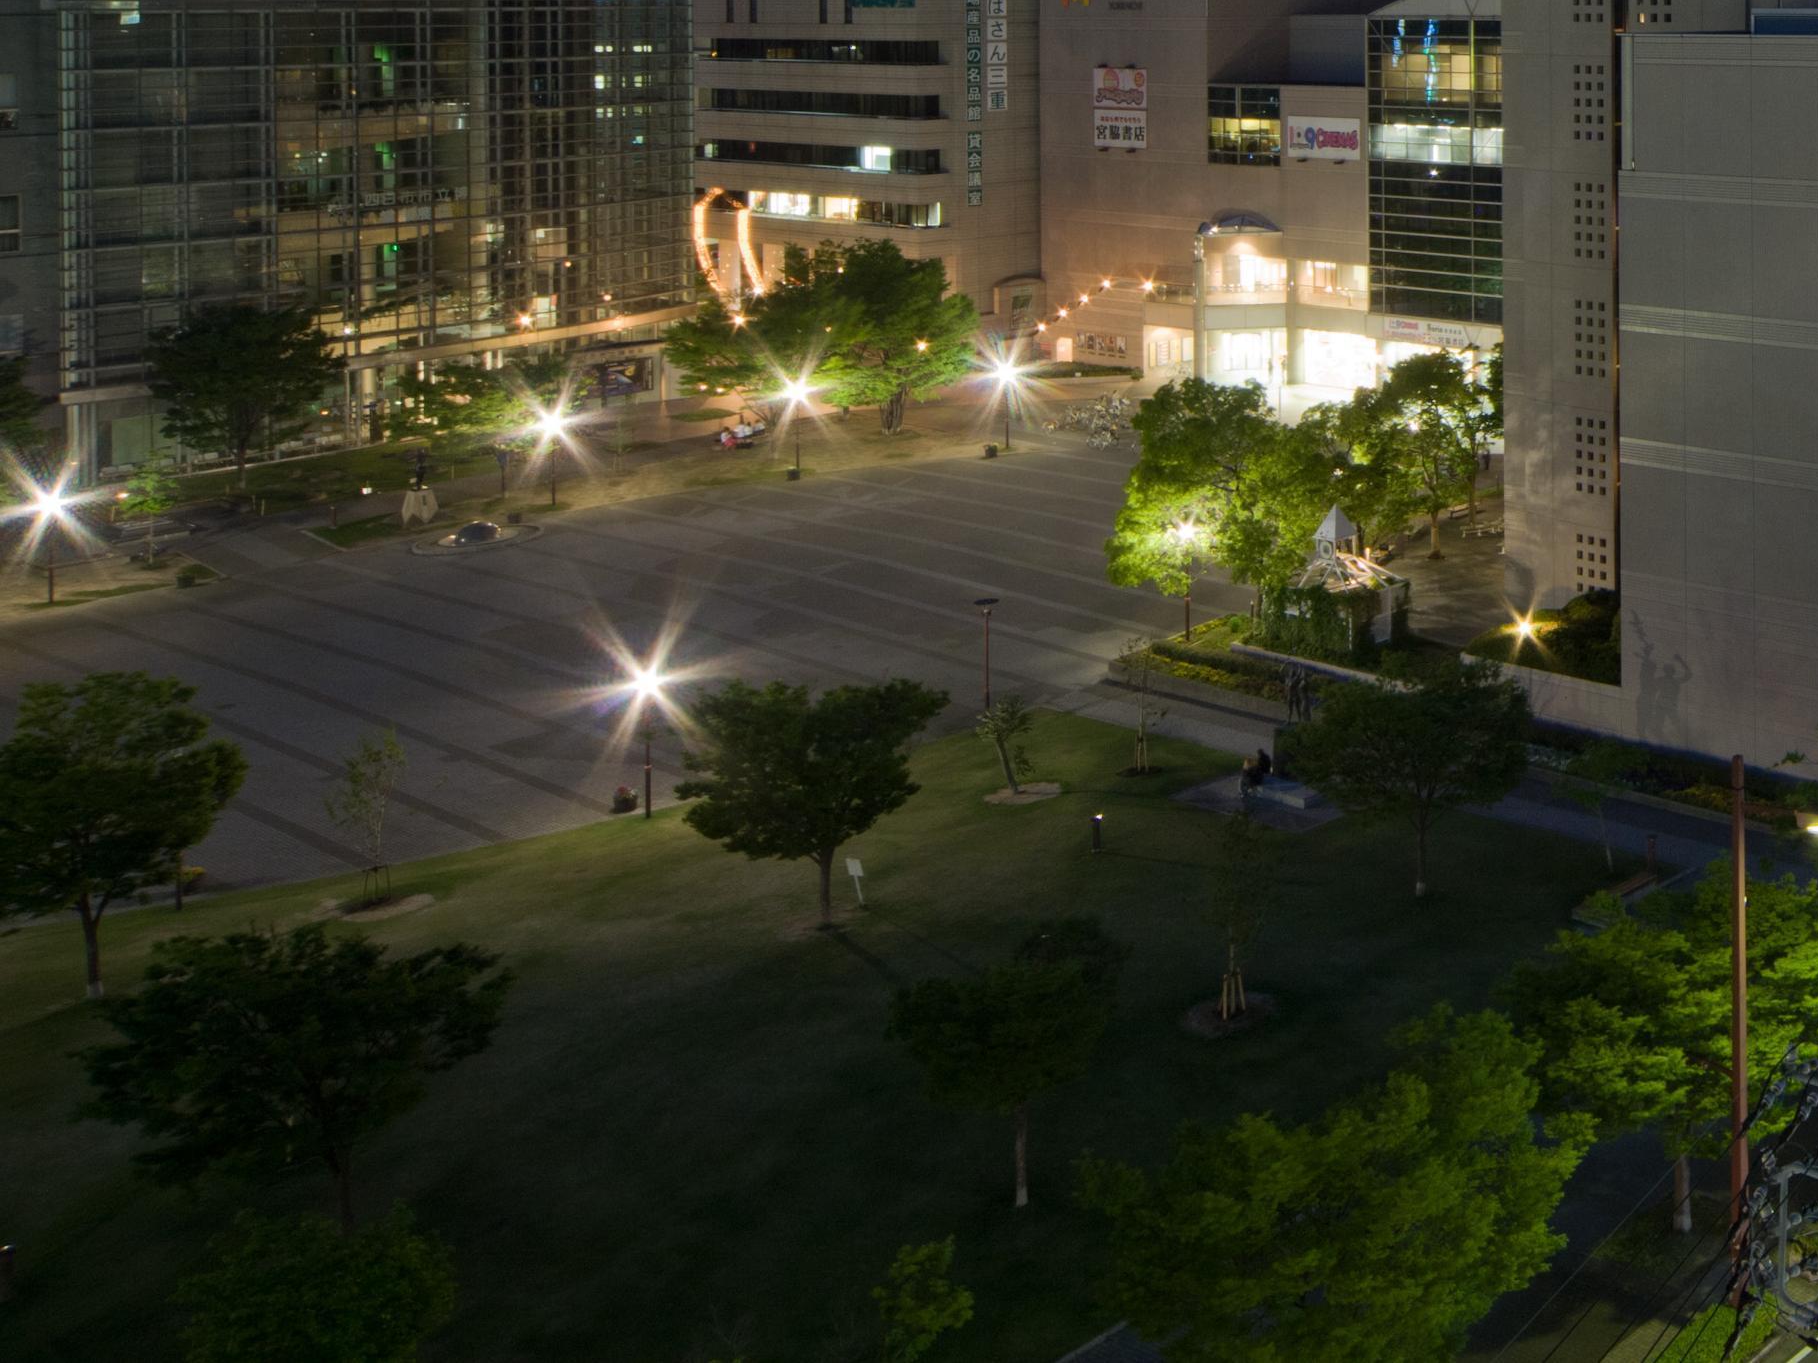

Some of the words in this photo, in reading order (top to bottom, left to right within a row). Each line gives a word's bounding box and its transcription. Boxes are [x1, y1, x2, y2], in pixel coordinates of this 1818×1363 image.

[1096, 125, 1145, 141] 宮脇書店
[1316, 127, 1359, 150] CINEMAS
